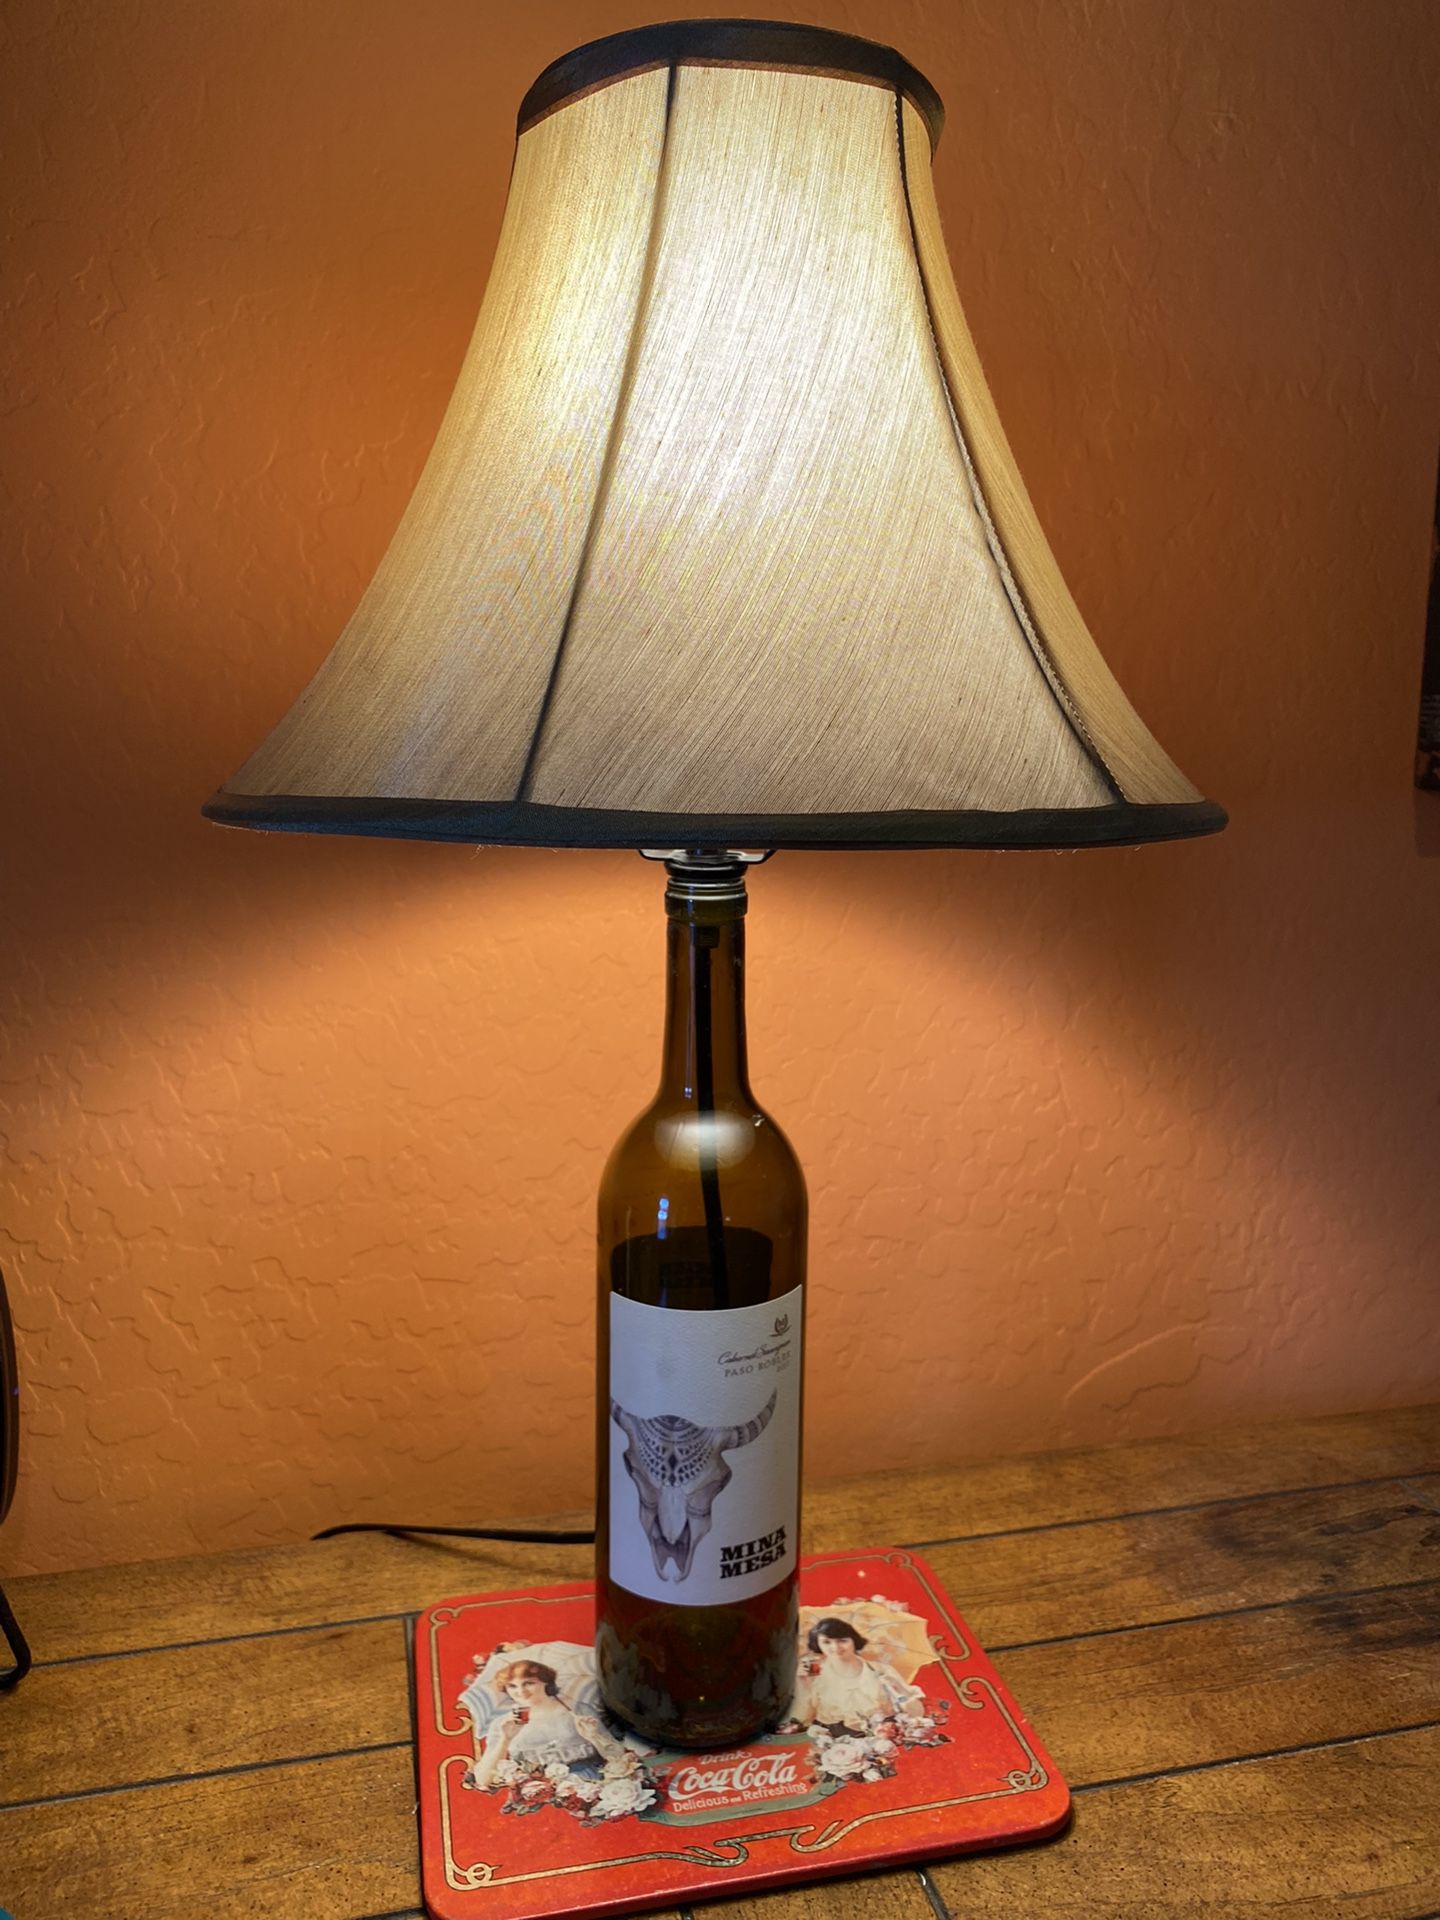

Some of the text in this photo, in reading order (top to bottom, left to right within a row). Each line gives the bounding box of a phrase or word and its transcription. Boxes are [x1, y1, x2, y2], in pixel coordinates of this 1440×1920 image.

[724, 1364, 754, 1377] PASO
[720, 1525, 786, 1562] MINA
[720, 1541, 786, 1579] MESA
[699, 1751, 752, 1764] Drink
[673, 1796, 730, 1812] Delicious
[742, 1782, 808, 1801] Refreshing
